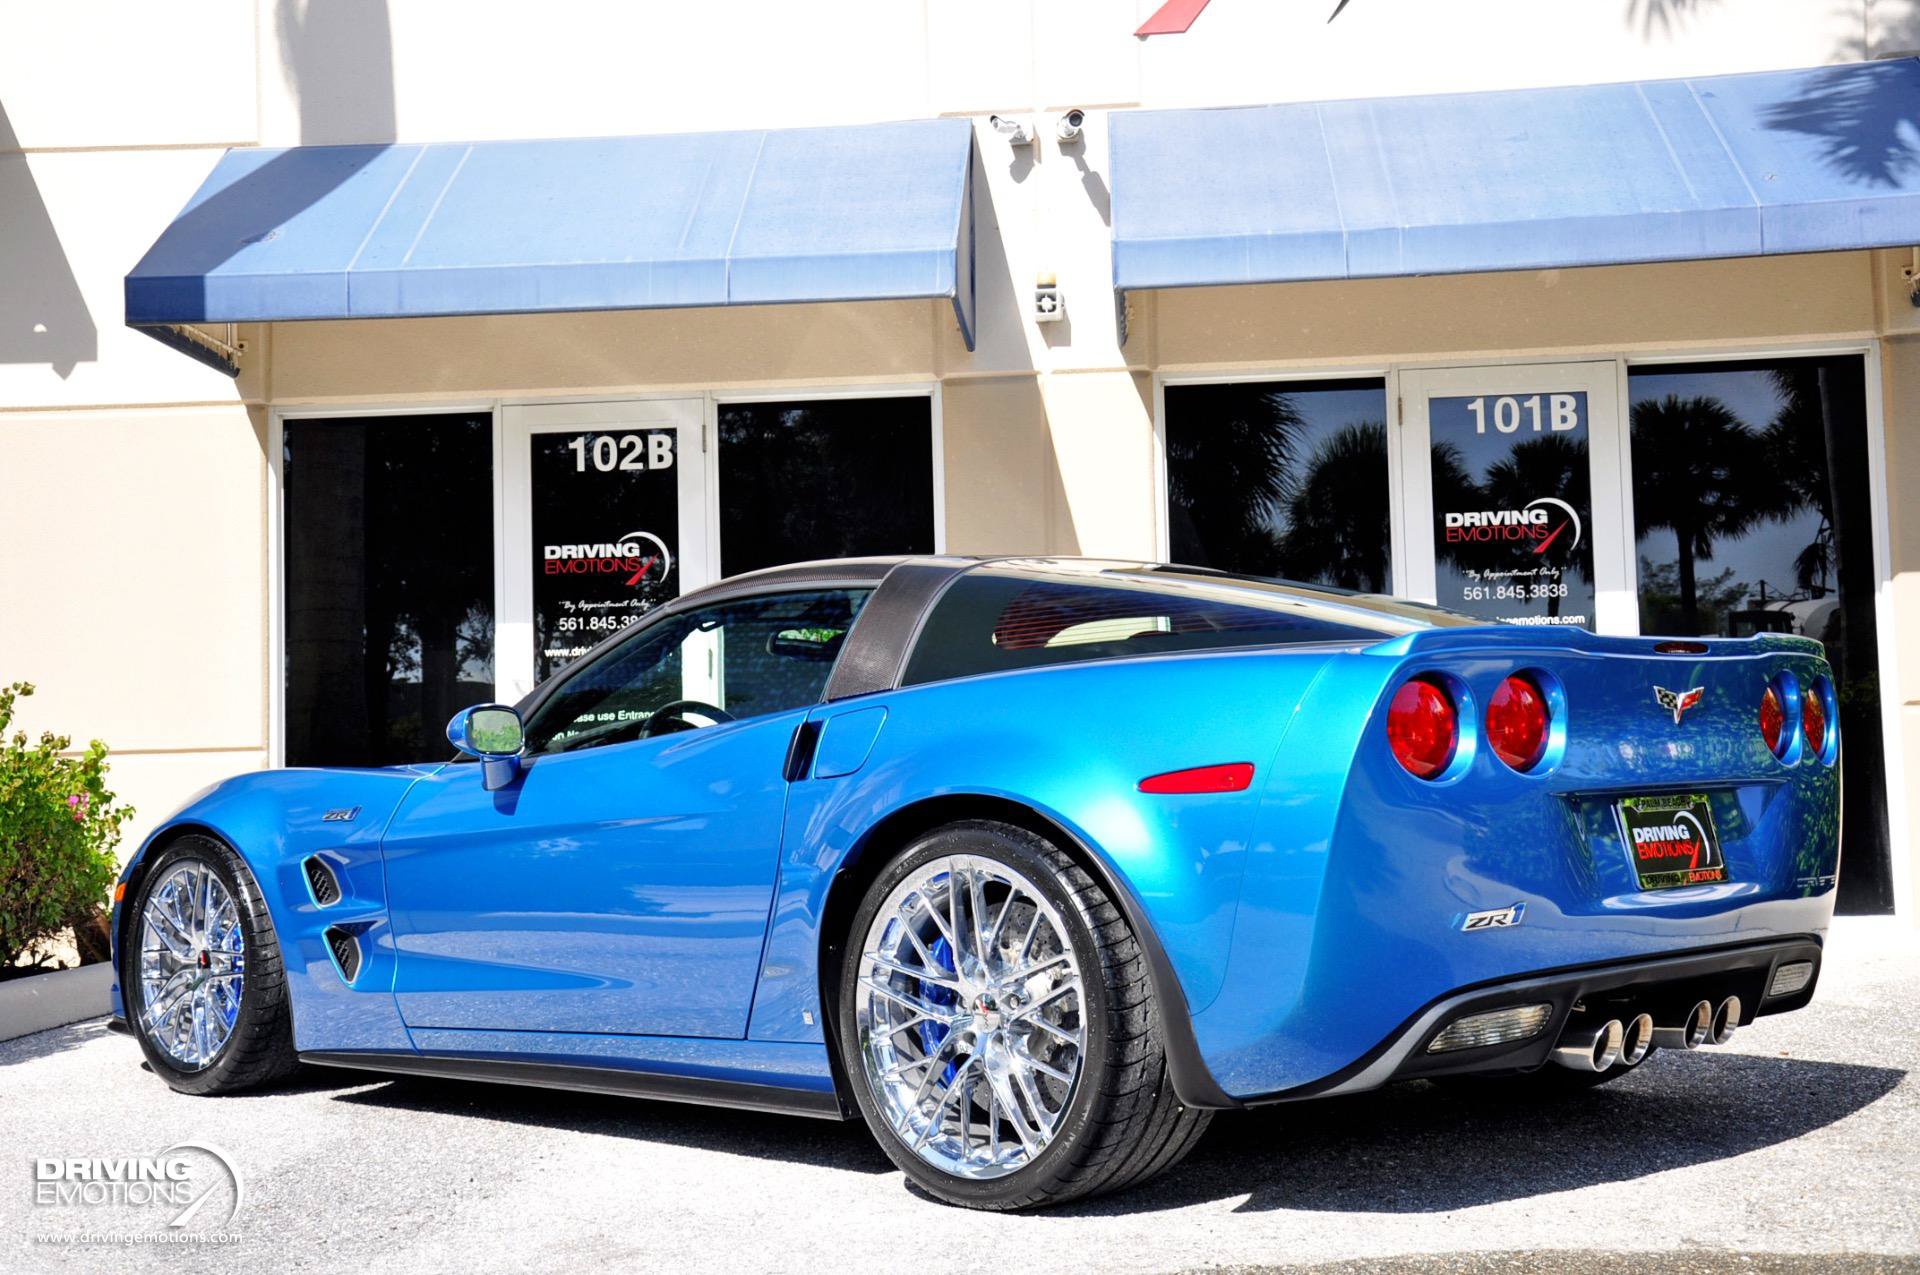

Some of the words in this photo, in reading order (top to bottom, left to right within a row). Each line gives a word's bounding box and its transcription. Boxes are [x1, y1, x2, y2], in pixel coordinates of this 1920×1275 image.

[1467, 394, 1578, 434] 101B
[568, 434, 673, 472] 102B
[1445, 509, 1549, 527] DRIVING
[1446, 525, 1549, 543] EMOTIONS
[544, 542, 640, 560] DRIVING
[545, 556, 641, 575] EMOTIONS
[1483, 568, 1538, 580] Appointment
[1463, 583, 1568, 600] 561.845.3838
[578, 599, 629, 612] Appointment
[559, 614, 644, 630] 561.845.38
[573, 712, 595, 723] ase
[597, 711, 616, 722] use
[1632, 824, 1691, 843] DRIVING
[1636, 840, 1694, 860] EMOTIONS
[1689, 868, 1722, 882] EMOTIONS
[1464, 902, 1527, 930] ZR1
